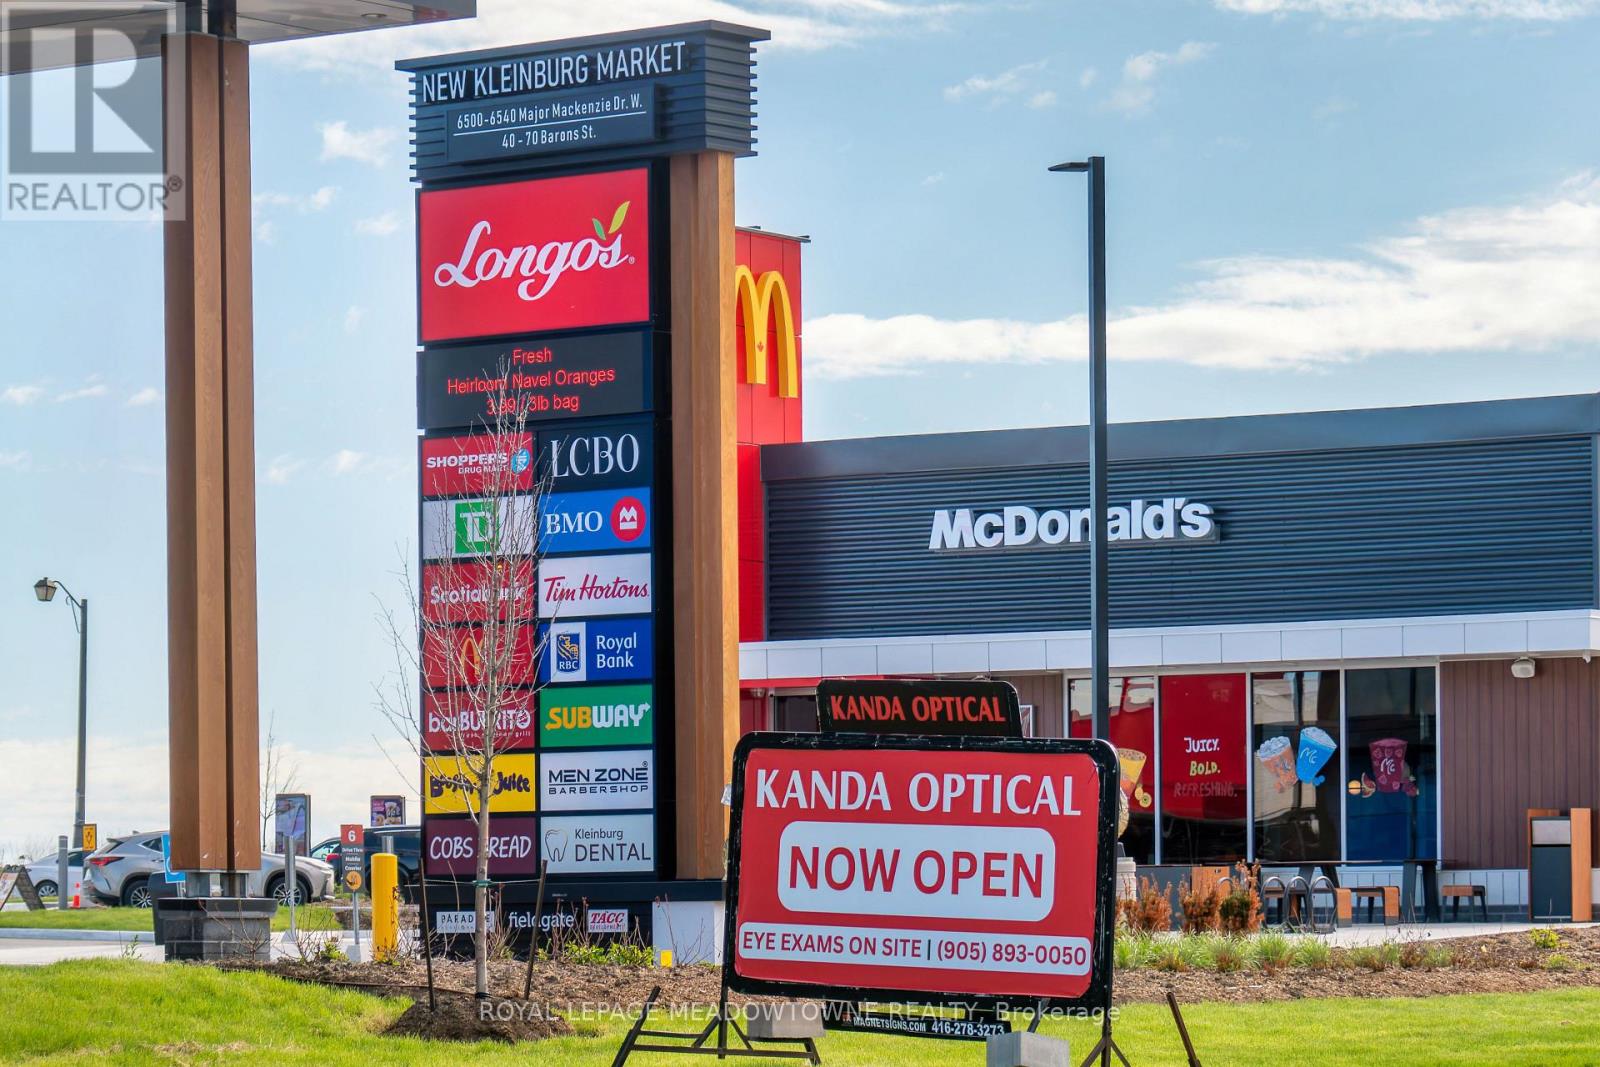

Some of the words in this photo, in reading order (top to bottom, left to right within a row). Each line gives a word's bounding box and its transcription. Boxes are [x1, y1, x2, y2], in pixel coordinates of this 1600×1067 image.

[422, 71, 466, 102] NEW
[474, 54, 588, 96] KLEINBURG
[597, 41, 686, 80] MARKET
[457, 106, 517, 130] 6500-6540
[518, 104, 550, 123] Major
[552, 97, 611, 117] Mackenzie
[613, 95, 629, 110] Dr.
[630, 93, 643, 109] W.
[541, 128, 579, 144] Barons
[581, 125, 597, 140] St.
[512, 346, 552, 365] Fresh
[447, 378, 508, 395] Heirloom
[512, 371, 551, 389] Navel
[555, 368, 616, 386] Oranges
[553, 394, 579, 412] bag
[426, 452, 508, 468] SHOPPERS
[551, 433, 639, 478] LCBO
[458, 466, 482, 474] DRUG
[460, 511, 494, 542] TD
[545, 510, 603, 535] BMO
[929, 498, 1213, 550] McDonald's
[430, 584, 527, 604] Scotiabnk
[543, 575, 575, 602] Tim
[579, 573, 648, 600] Hortons
[596, 632, 637, 655] Royal
[558, 661, 578, 670] RBC
[597, 654, 634, 669] Bank
[545, 702, 651, 730] SUBWAY
[830, 695, 905, 721] KANDA
[912, 696, 1006, 722] OPTICAL
[1184, 737, 1220, 753] JUICY.
[549, 769, 590, 783] MEN
[1189, 760, 1221, 776] BOLD.
[493, 771, 531, 795] Juice
[549, 785, 648, 795] BARBERSHOP
[755, 769, 891, 811] KANDA
[908, 772, 1081, 816] OPTICAL
[348, 830, 356, 842] 6
[575, 828, 623, 840] Kleinburg
[430, 836, 474, 860] COBS
[488, 835, 532, 858] READ
[575, 842, 651, 862] DENTAL
[789, 845, 900, 893] NOW
[913, 849, 1044, 899] OPEN
[441, 914, 490, 923] PARADE
[591, 912, 625, 923] TACC
[743, 931, 776, 951] EYE
[781, 933, 844, 954] EXAMS
[849, 936, 877, 955] ON
[882, 938, 921, 957] SITE
[937, 940, 987, 963] (905)
[992, 942, 1087, 965] 893-0050
[853, 1017, 926, 1032] MAGNETSIGNS.COM
[931, 1021, 1004, 1036] 416-278-3273
